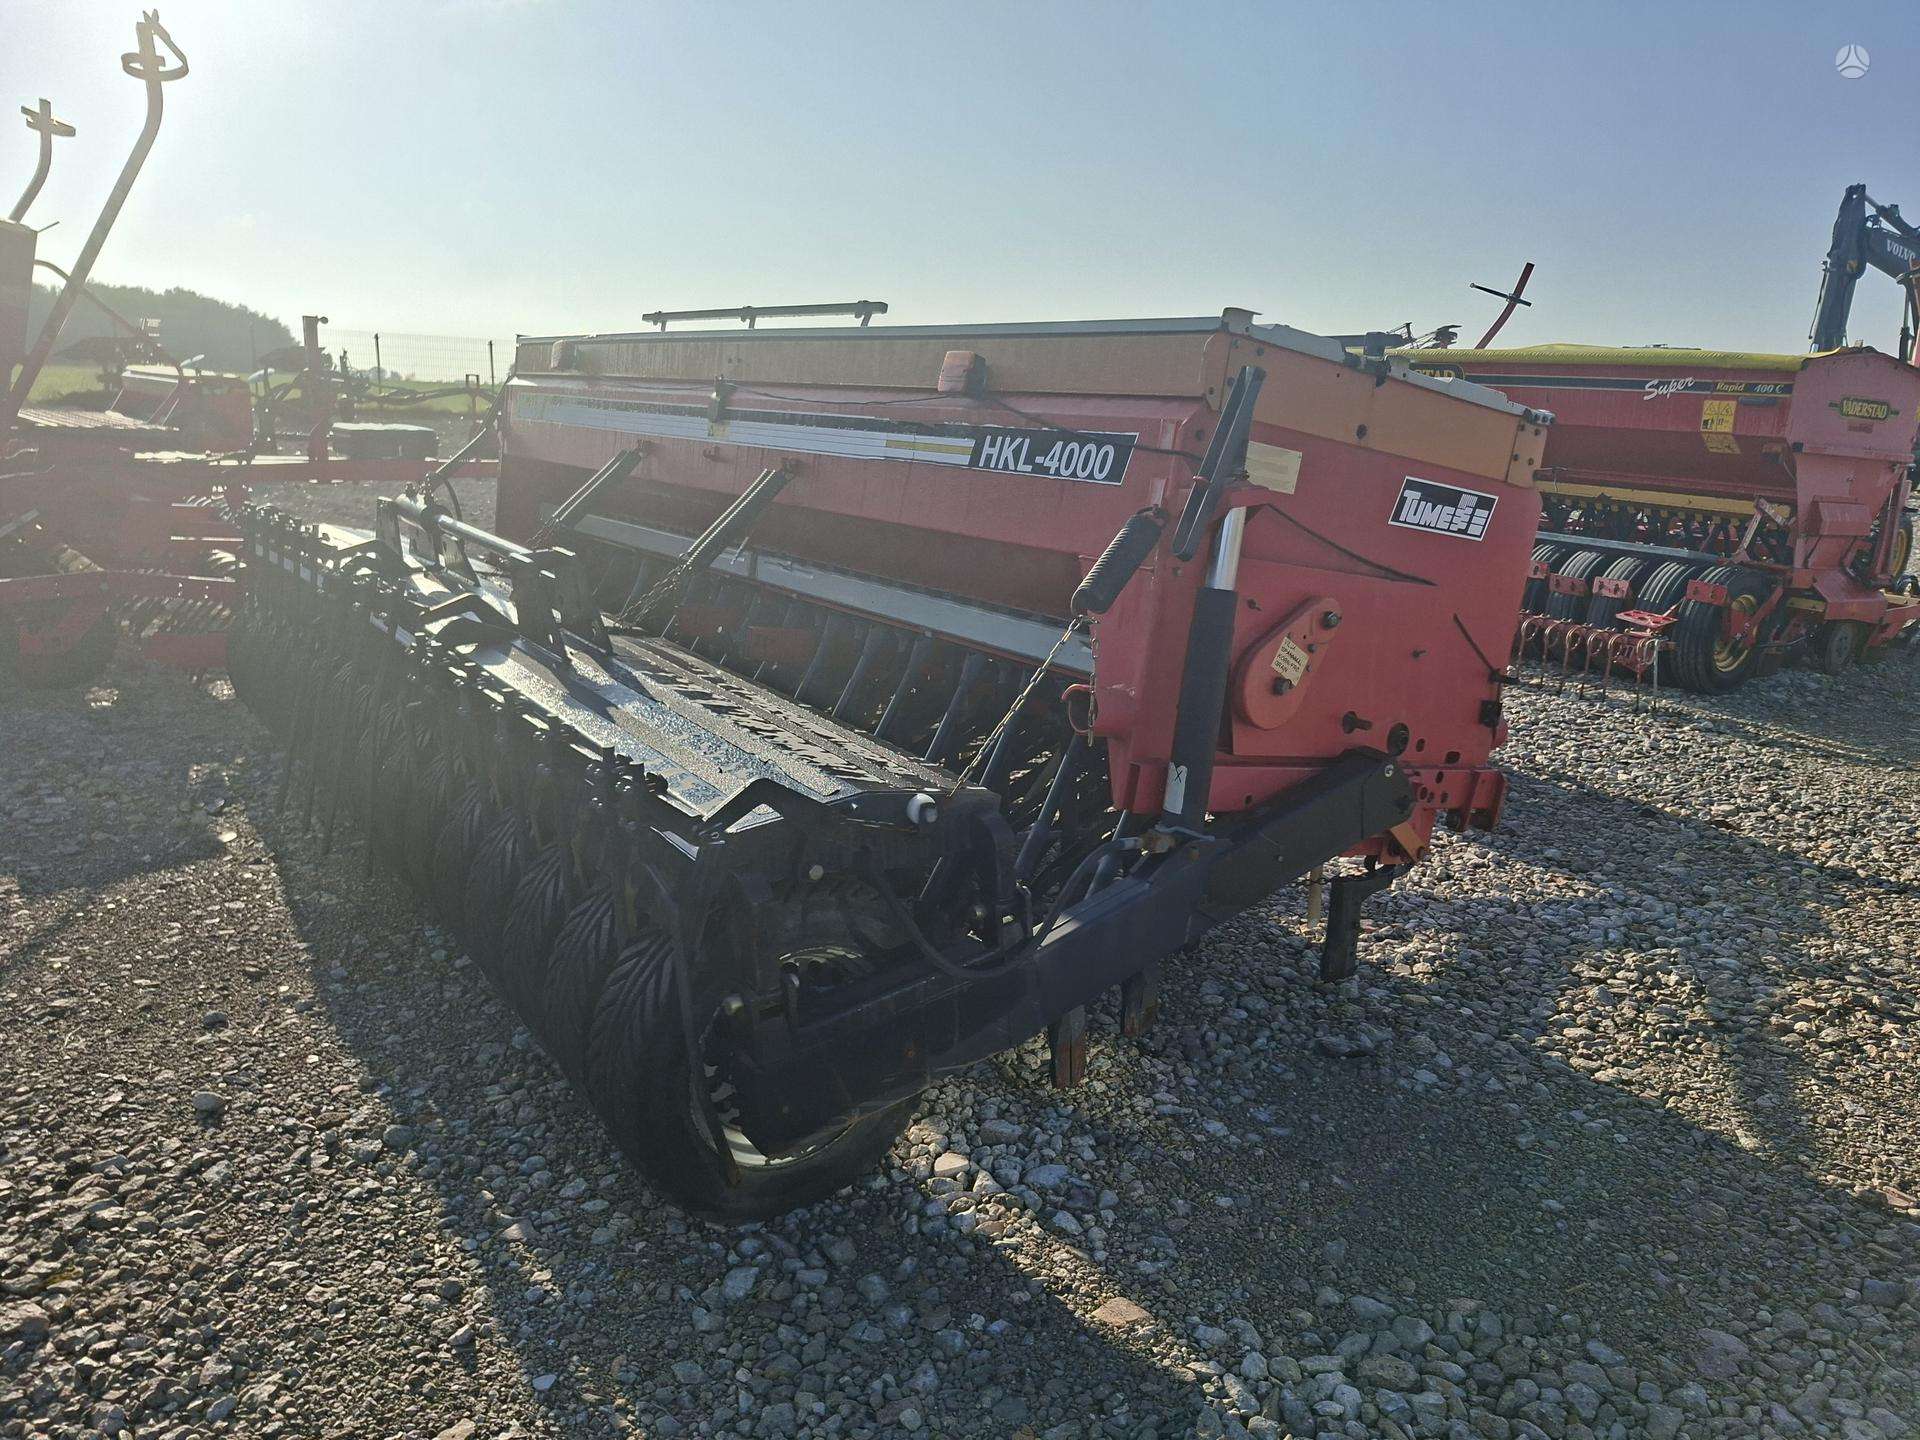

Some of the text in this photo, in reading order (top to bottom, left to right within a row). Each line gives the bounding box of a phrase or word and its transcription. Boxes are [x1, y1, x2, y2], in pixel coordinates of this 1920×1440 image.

[1643, 376, 1695, 400] Super
[1716, 382, 1745, 393] Rapid
[979, 435, 1114, 480] HKL-4000
